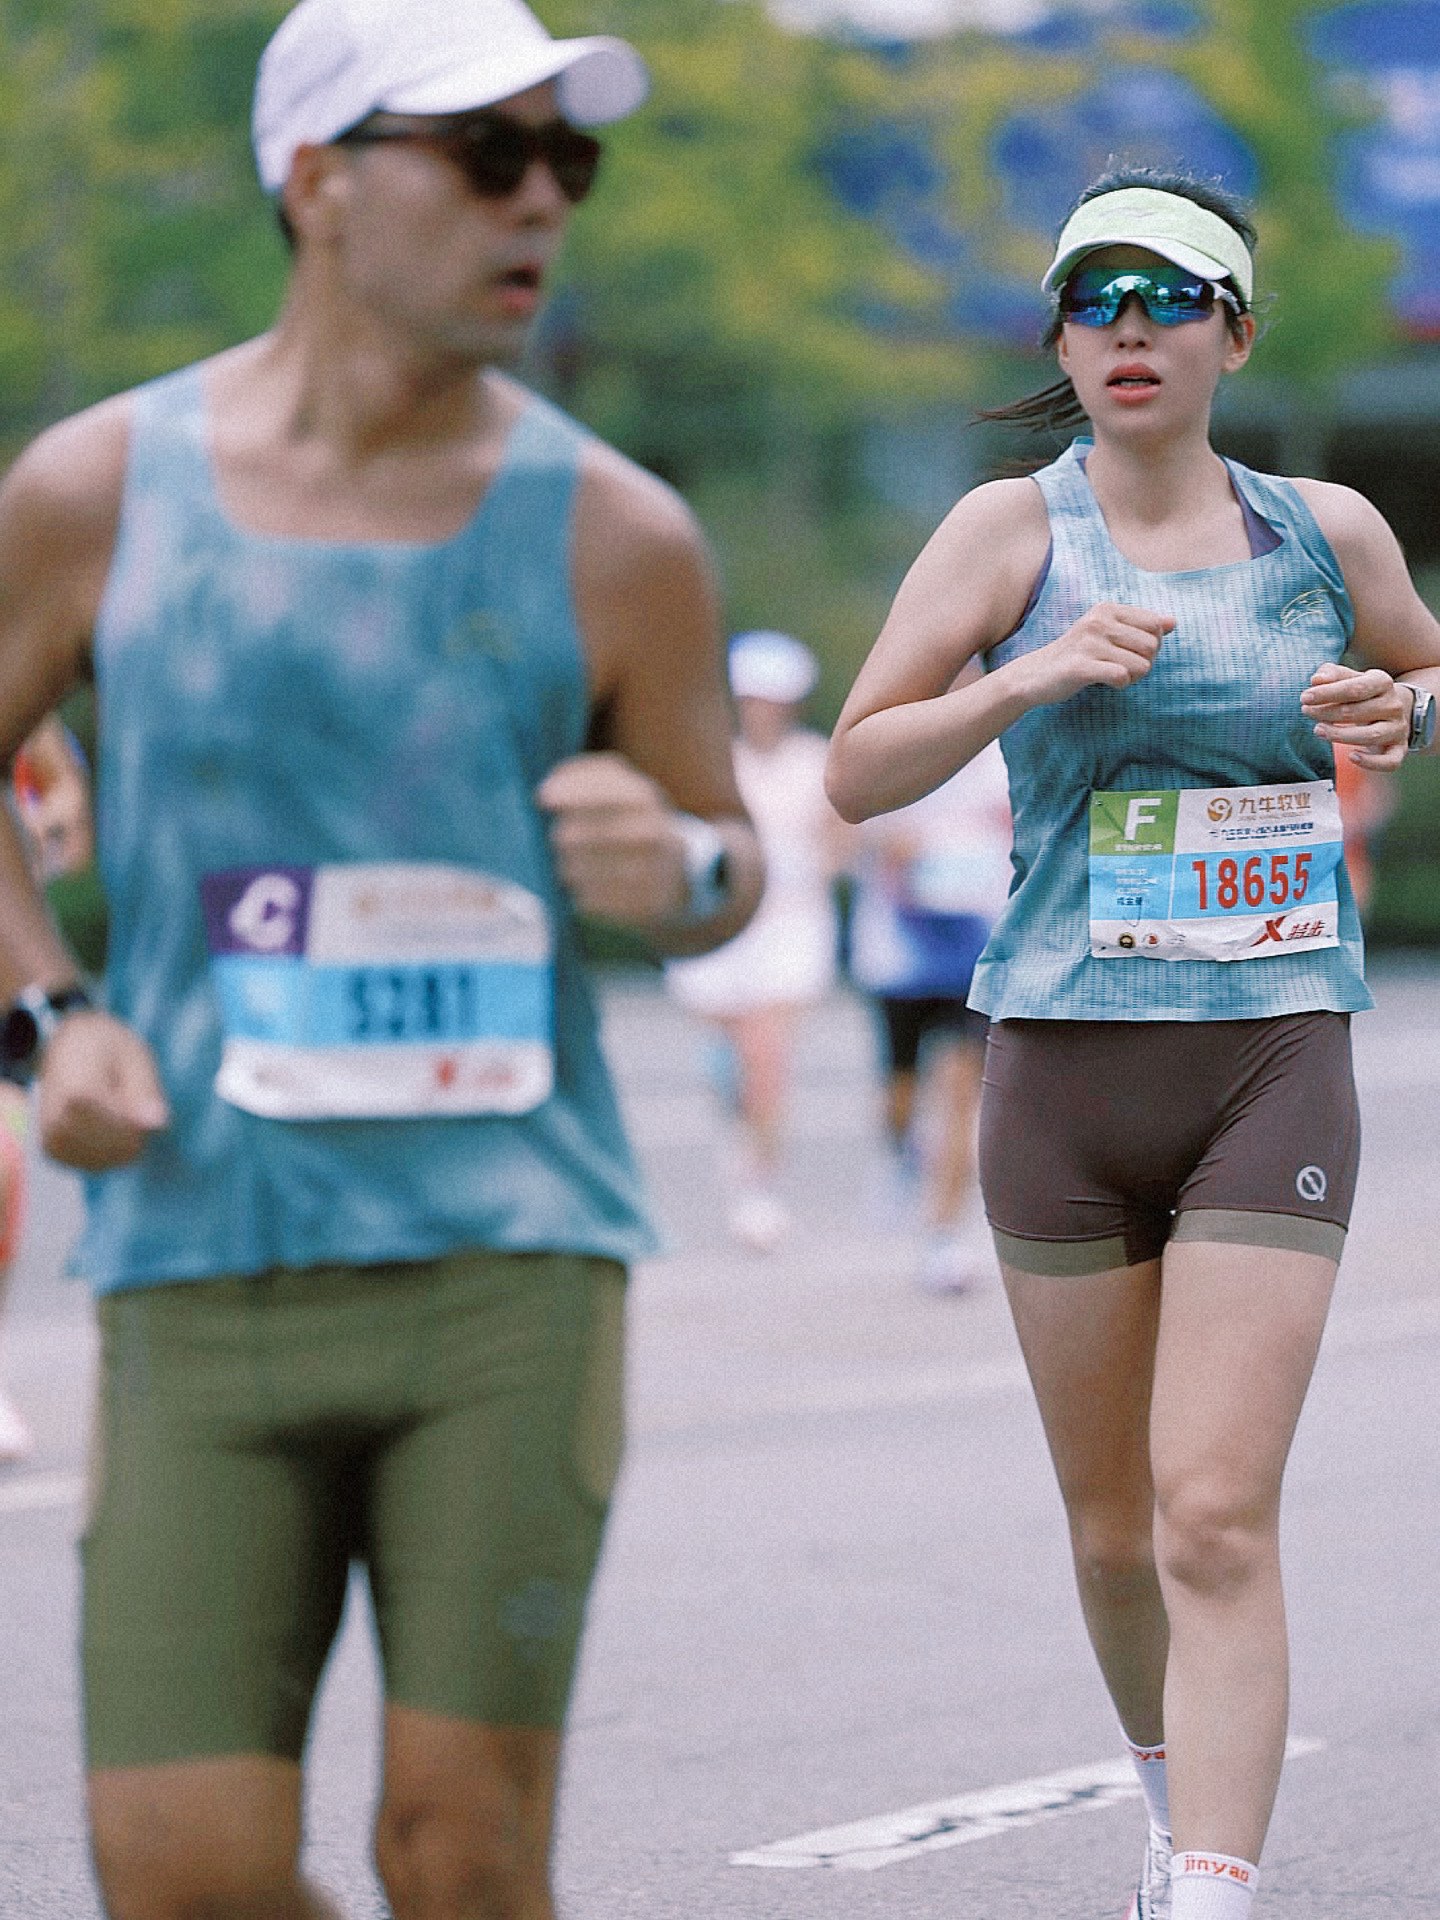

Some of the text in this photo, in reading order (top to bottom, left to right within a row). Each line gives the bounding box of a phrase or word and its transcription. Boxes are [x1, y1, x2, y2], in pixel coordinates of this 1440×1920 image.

[1238, 792, 1311, 813] 九牛牧业
[1123, 797, 1162, 841] F
[1192, 852, 1312, 910] 18655
[1286, 919, 1326, 941] 特步
[1185, 1855, 1249, 1882] jinyao
